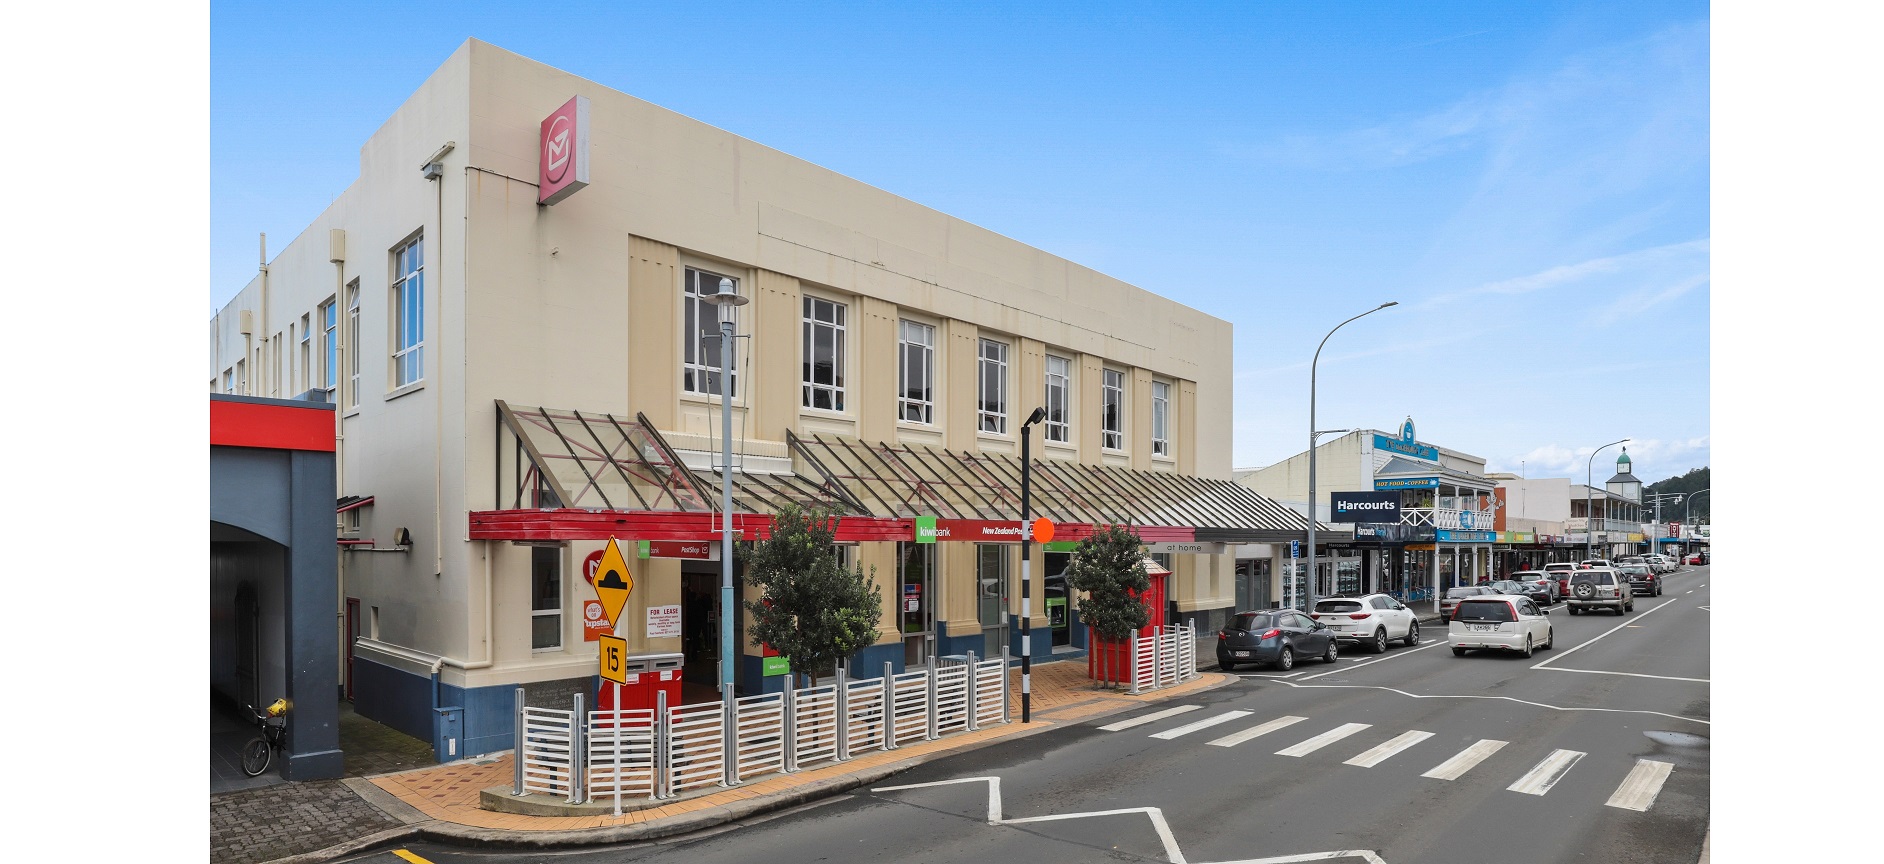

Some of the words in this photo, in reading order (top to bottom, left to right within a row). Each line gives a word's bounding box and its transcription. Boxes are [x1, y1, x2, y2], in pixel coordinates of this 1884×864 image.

[1337, 500, 1395, 510] Harcourts
[919, 526, 951, 537] kiwibank
[982, 527, 994, 535] New
[994, 527, 1014, 535] Zealand
[1014, 527, 1023, 535] Pos
[1357, 526, 1375, 536] Harcourts
[681, 546, 699, 555] PostShop
[1167, 543, 1176, 551] at
[1178, 543, 1202, 551] home
[586, 619, 610, 629] upsta
[606, 646, 619, 672] 15
